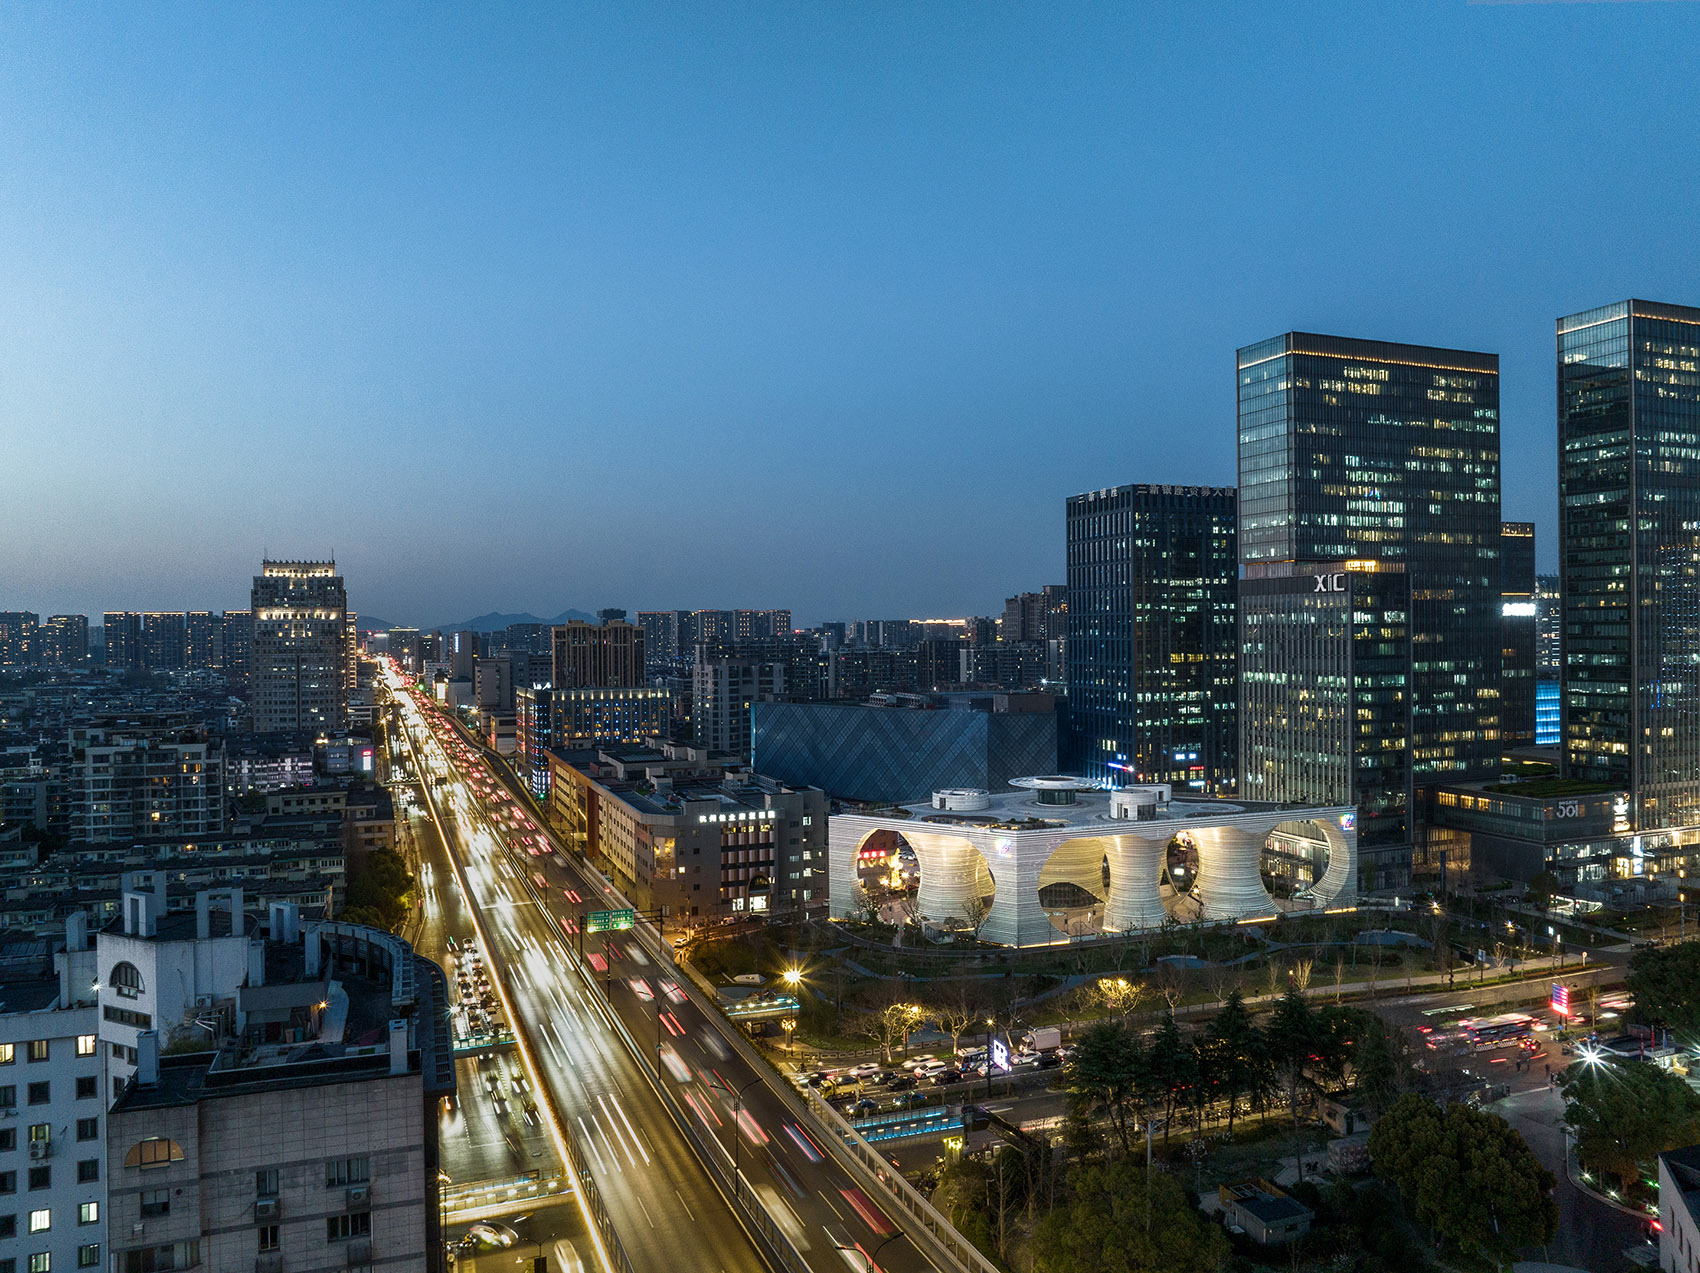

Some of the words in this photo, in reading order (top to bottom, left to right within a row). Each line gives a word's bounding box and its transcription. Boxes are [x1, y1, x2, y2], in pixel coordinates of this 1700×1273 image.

[1078, 486, 1118, 504] 三新银座
[1314, 574, 1344, 592] XIC
